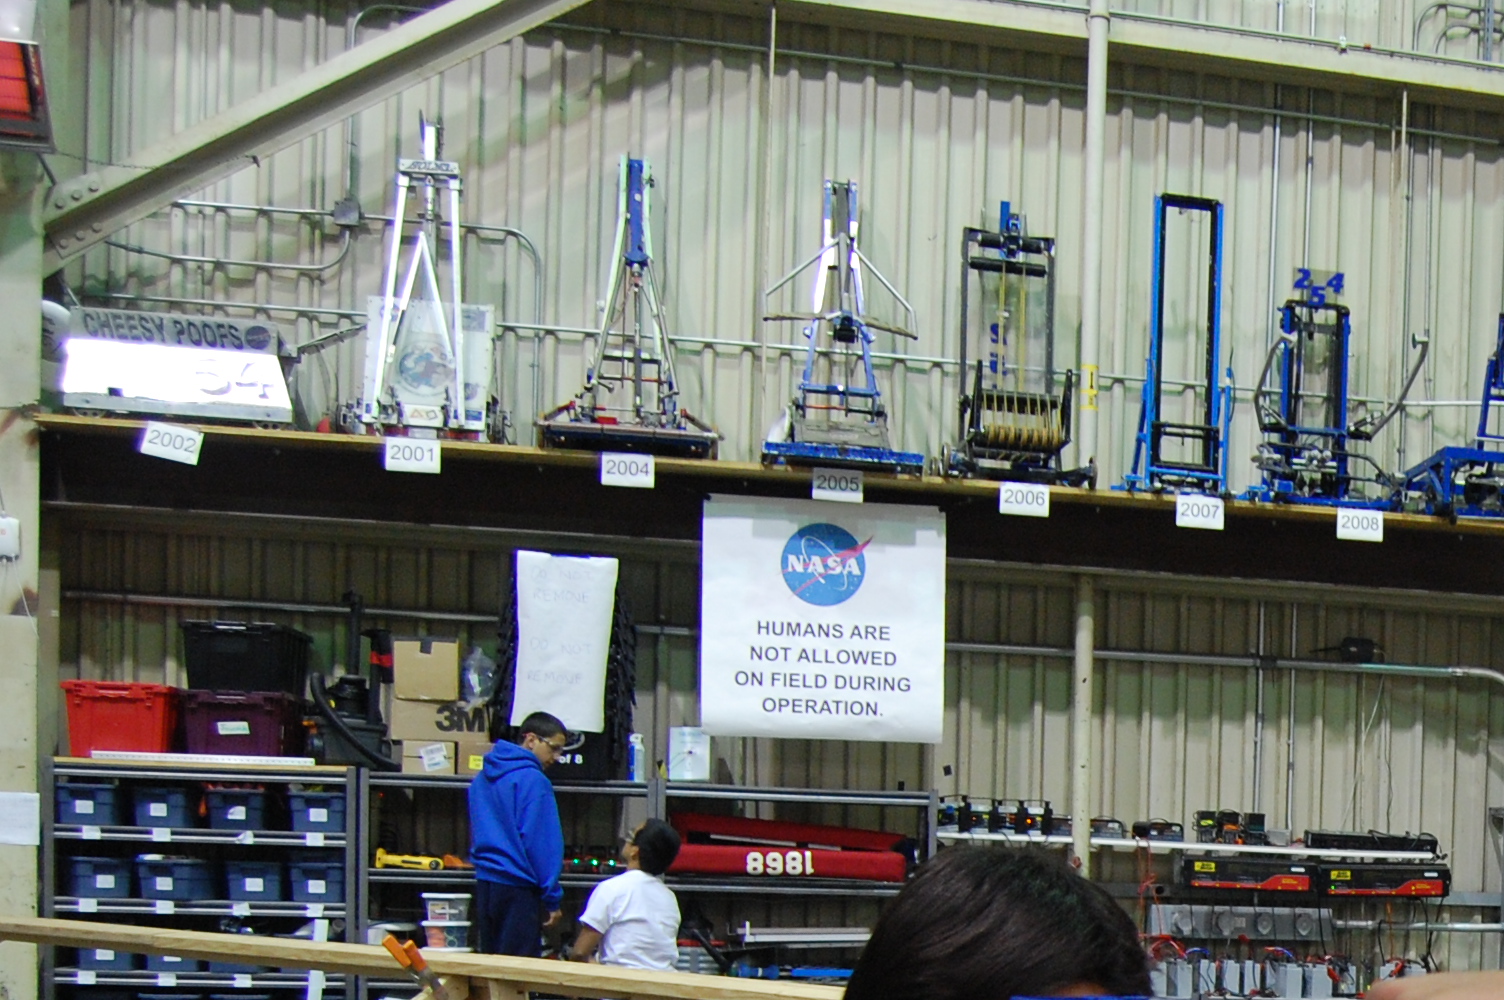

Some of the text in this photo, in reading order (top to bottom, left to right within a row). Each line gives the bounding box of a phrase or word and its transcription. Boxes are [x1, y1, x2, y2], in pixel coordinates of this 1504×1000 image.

[83, 312, 167, 343] CHEESY
[173, 319, 245, 350] POOFS
[148, 429, 197, 454] 2002
[389, 444, 435, 463] 2001
[606, 459, 650, 478] 2004
[816, 474, 860, 493] 2005
[1003, 488, 1046, 507] 2006
[1180, 501, 1221, 519] 2007
[1341, 514, 1380, 532] 2008
[787, 554, 862, 576] NASA
[757, 620, 891, 641] HUMANS ARE
[749, 646, 898, 667] NOT ALLOWED
[734, 671, 912, 693] ON FIELD DURING
[762, 697, 884, 717] OPERATION.
[434, 703, 486, 733] 3M
